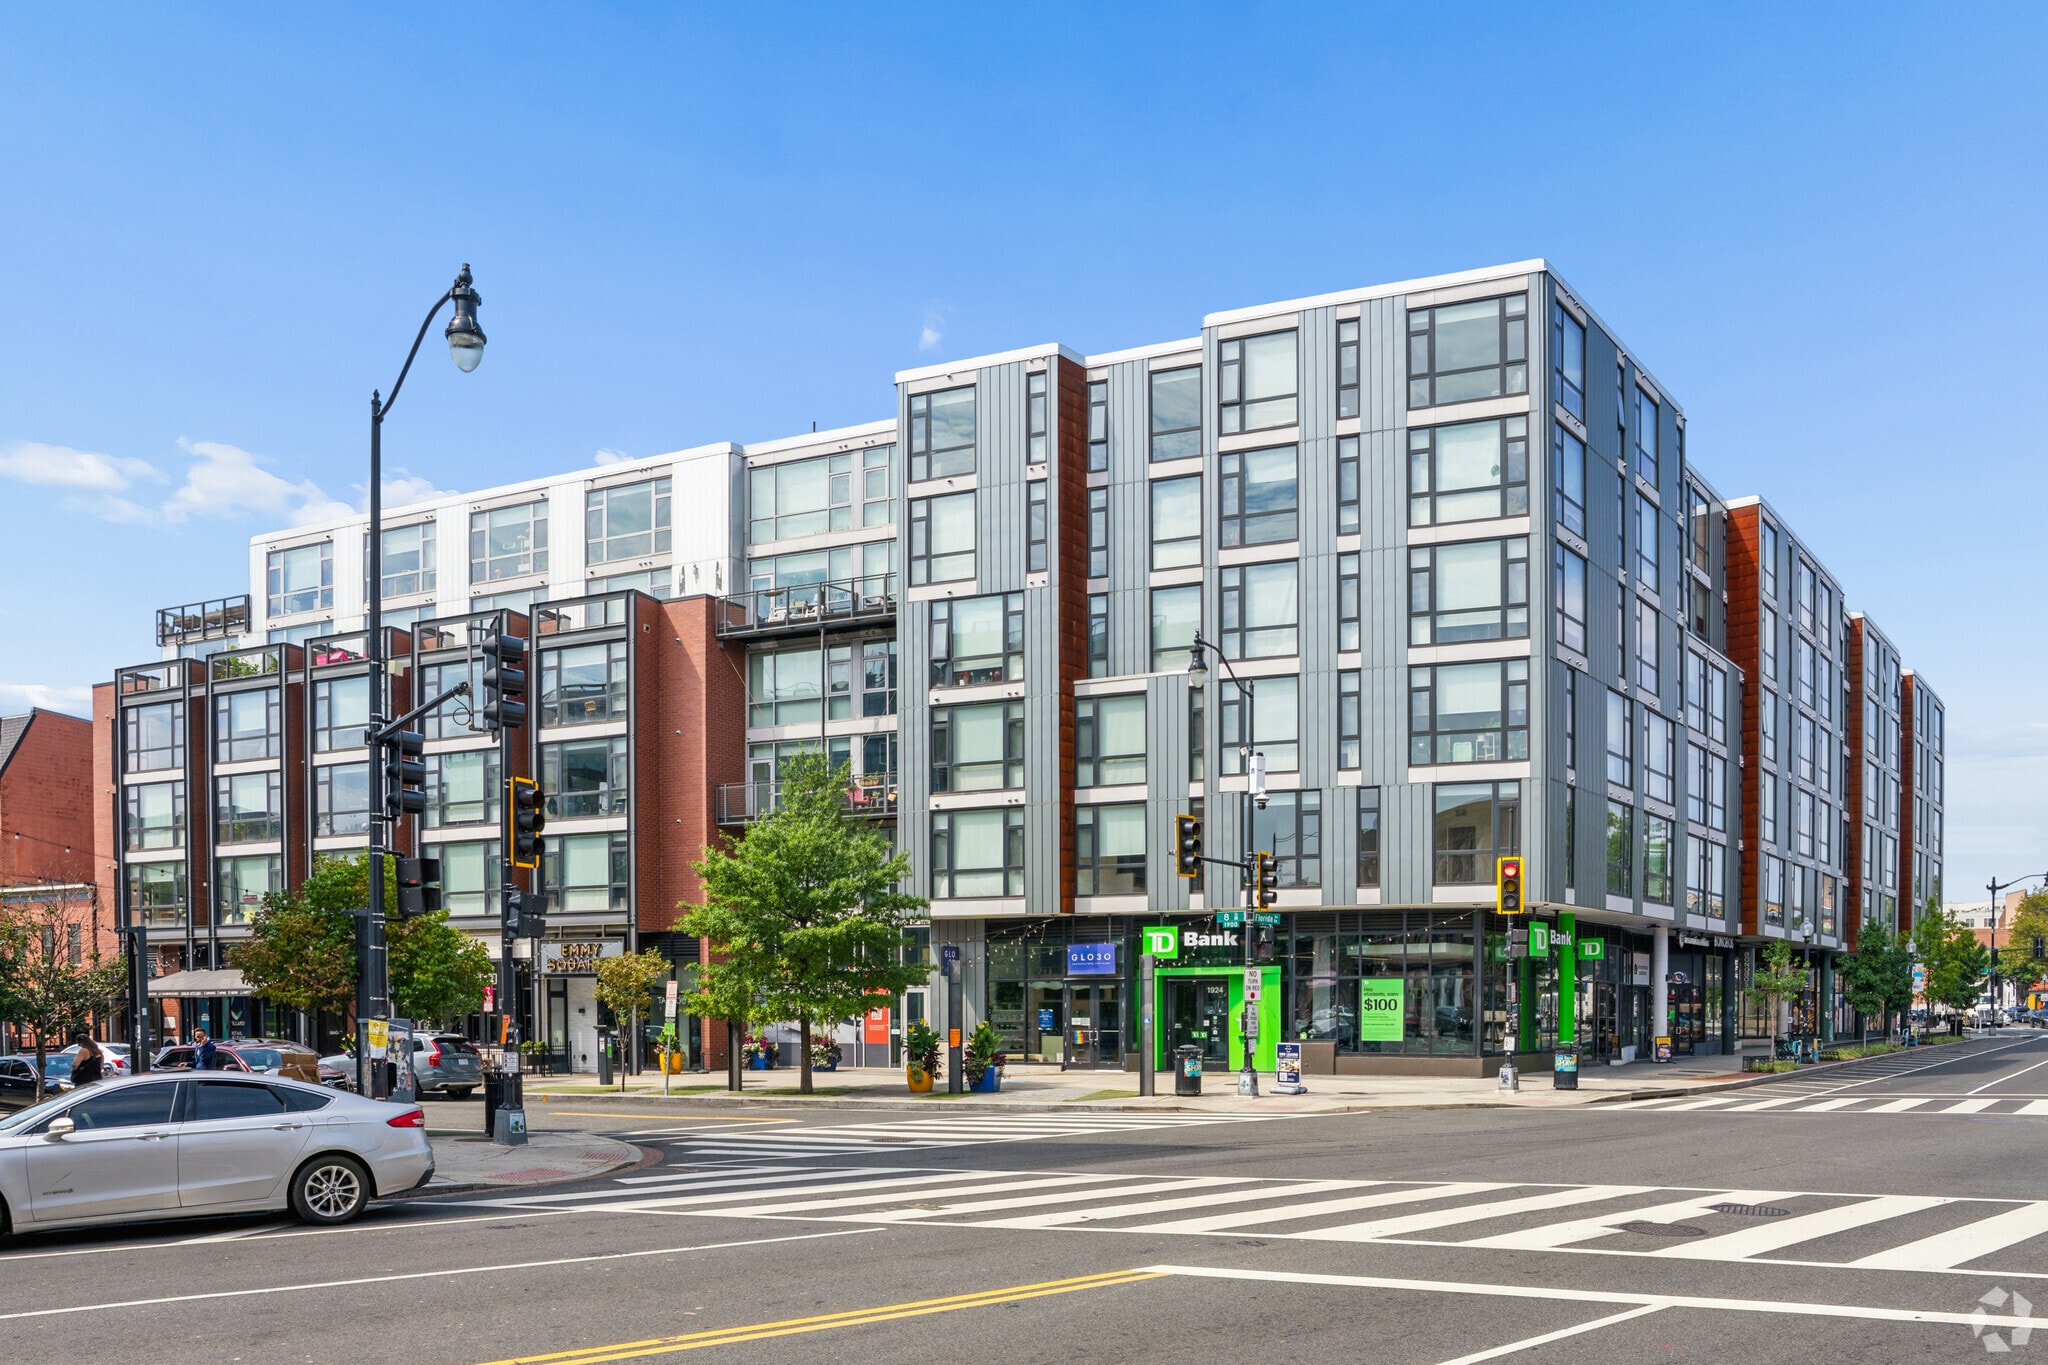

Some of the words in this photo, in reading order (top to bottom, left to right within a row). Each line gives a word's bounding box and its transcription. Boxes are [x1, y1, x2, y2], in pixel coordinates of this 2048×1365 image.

[1223, 913, 1230, 922] 8
[1255, 913, 1274, 923] Florida
[1146, 932, 1175, 953] TD
[1184, 930, 1238, 946] Bank
[1534, 928, 1547, 950] TD
[1550, 929, 1572, 945] Bank
[560, 943, 601, 957] EMMY
[1581, 942, 1600, 956] TD
[1743, 952, 1751, 987] BONOBOS
[1207, 986, 1224, 994] 1924
[1364, 998, 1398, 1011] $100
